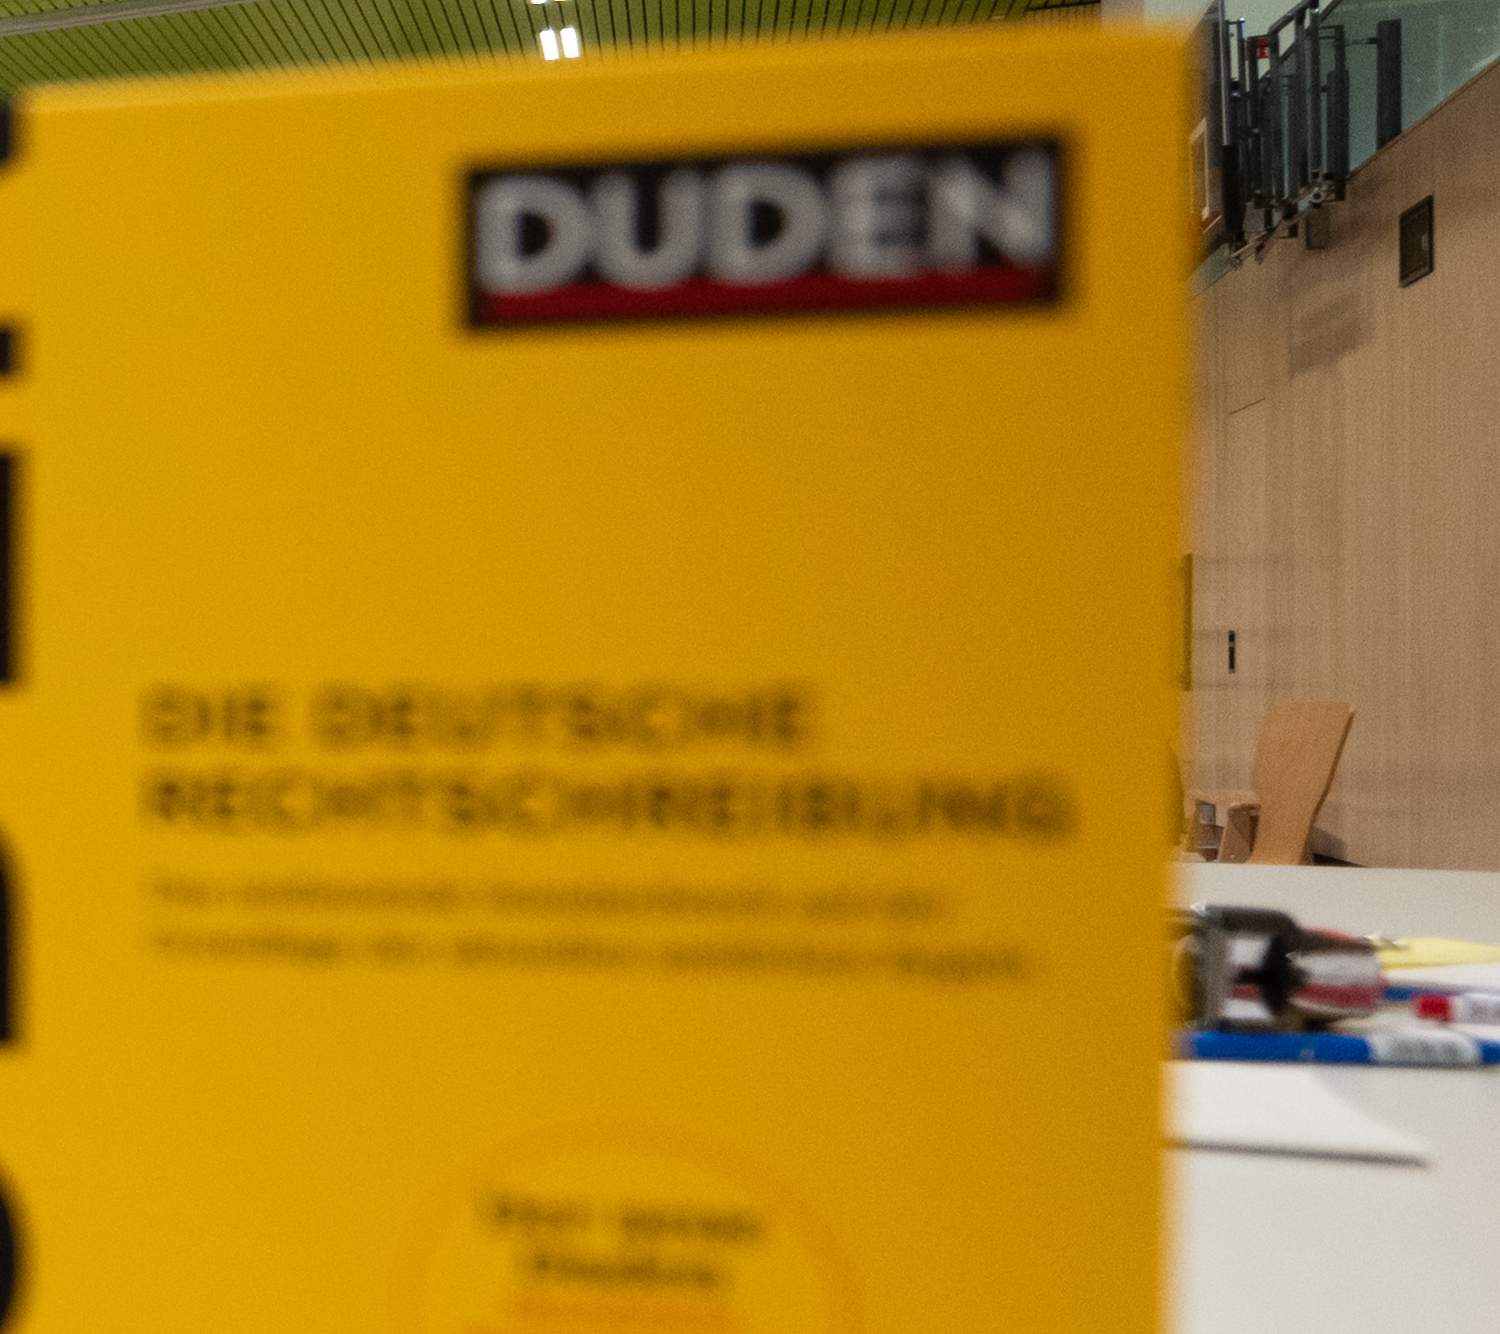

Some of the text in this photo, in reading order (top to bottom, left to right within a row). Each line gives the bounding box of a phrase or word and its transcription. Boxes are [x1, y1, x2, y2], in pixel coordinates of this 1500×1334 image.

[475, 152, 1056, 294] DUDEN
[140, 680, 810, 753] DIE DEUTSCHE
[140, 765, 1078, 841] RECHTSCHREIBUNG
